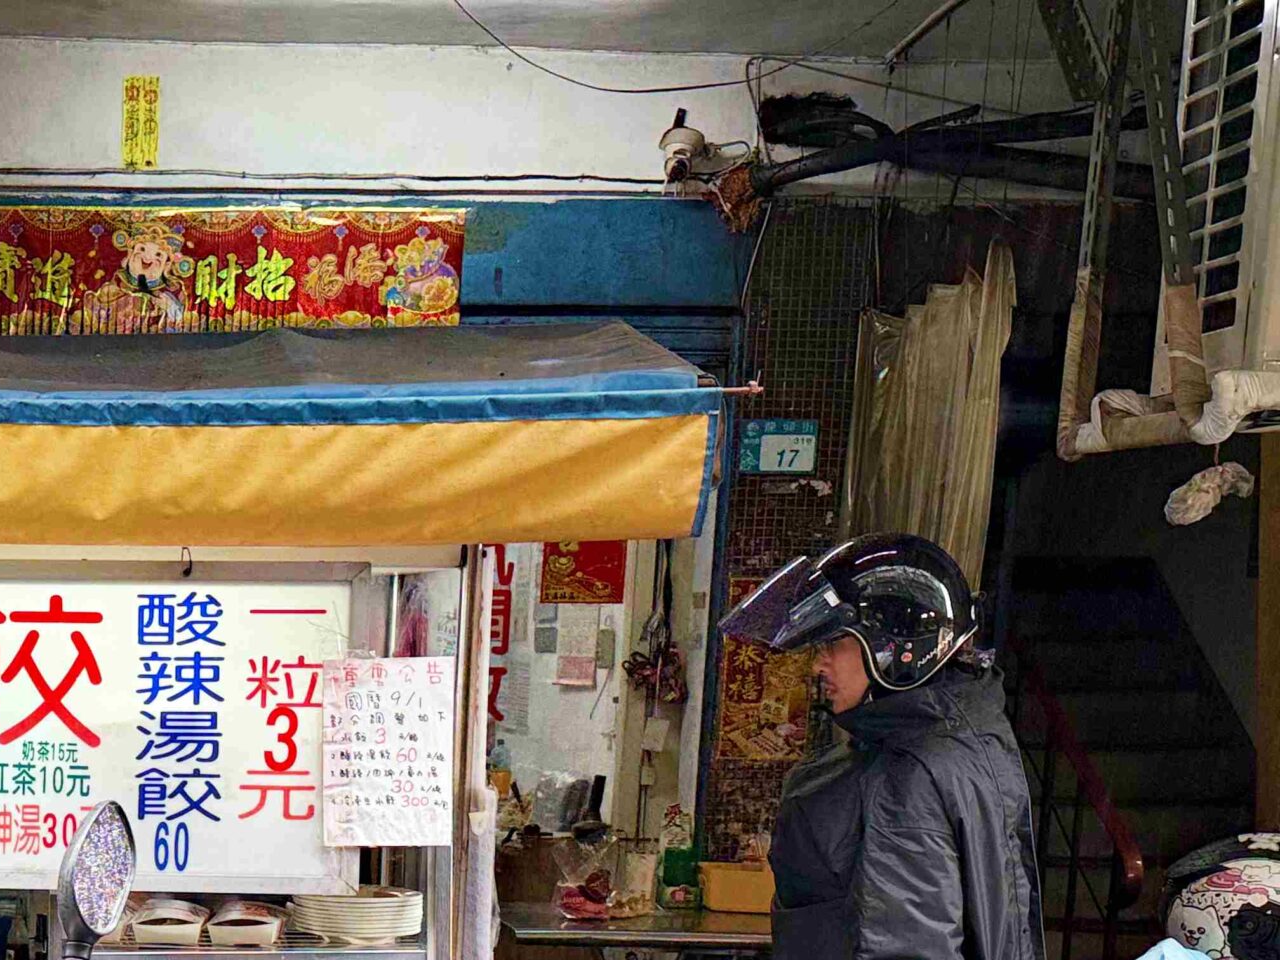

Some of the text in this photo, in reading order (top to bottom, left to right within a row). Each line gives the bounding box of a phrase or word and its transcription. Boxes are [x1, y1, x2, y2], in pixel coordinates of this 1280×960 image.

[777, 449, 800, 468] 17
[135, 591, 226, 822] 酸辣湯餃
[238, 609, 326, 821] 一粒3元
[21, 741, 78, 763] 奶茶15元
[153, 821, 190, 872] 60
